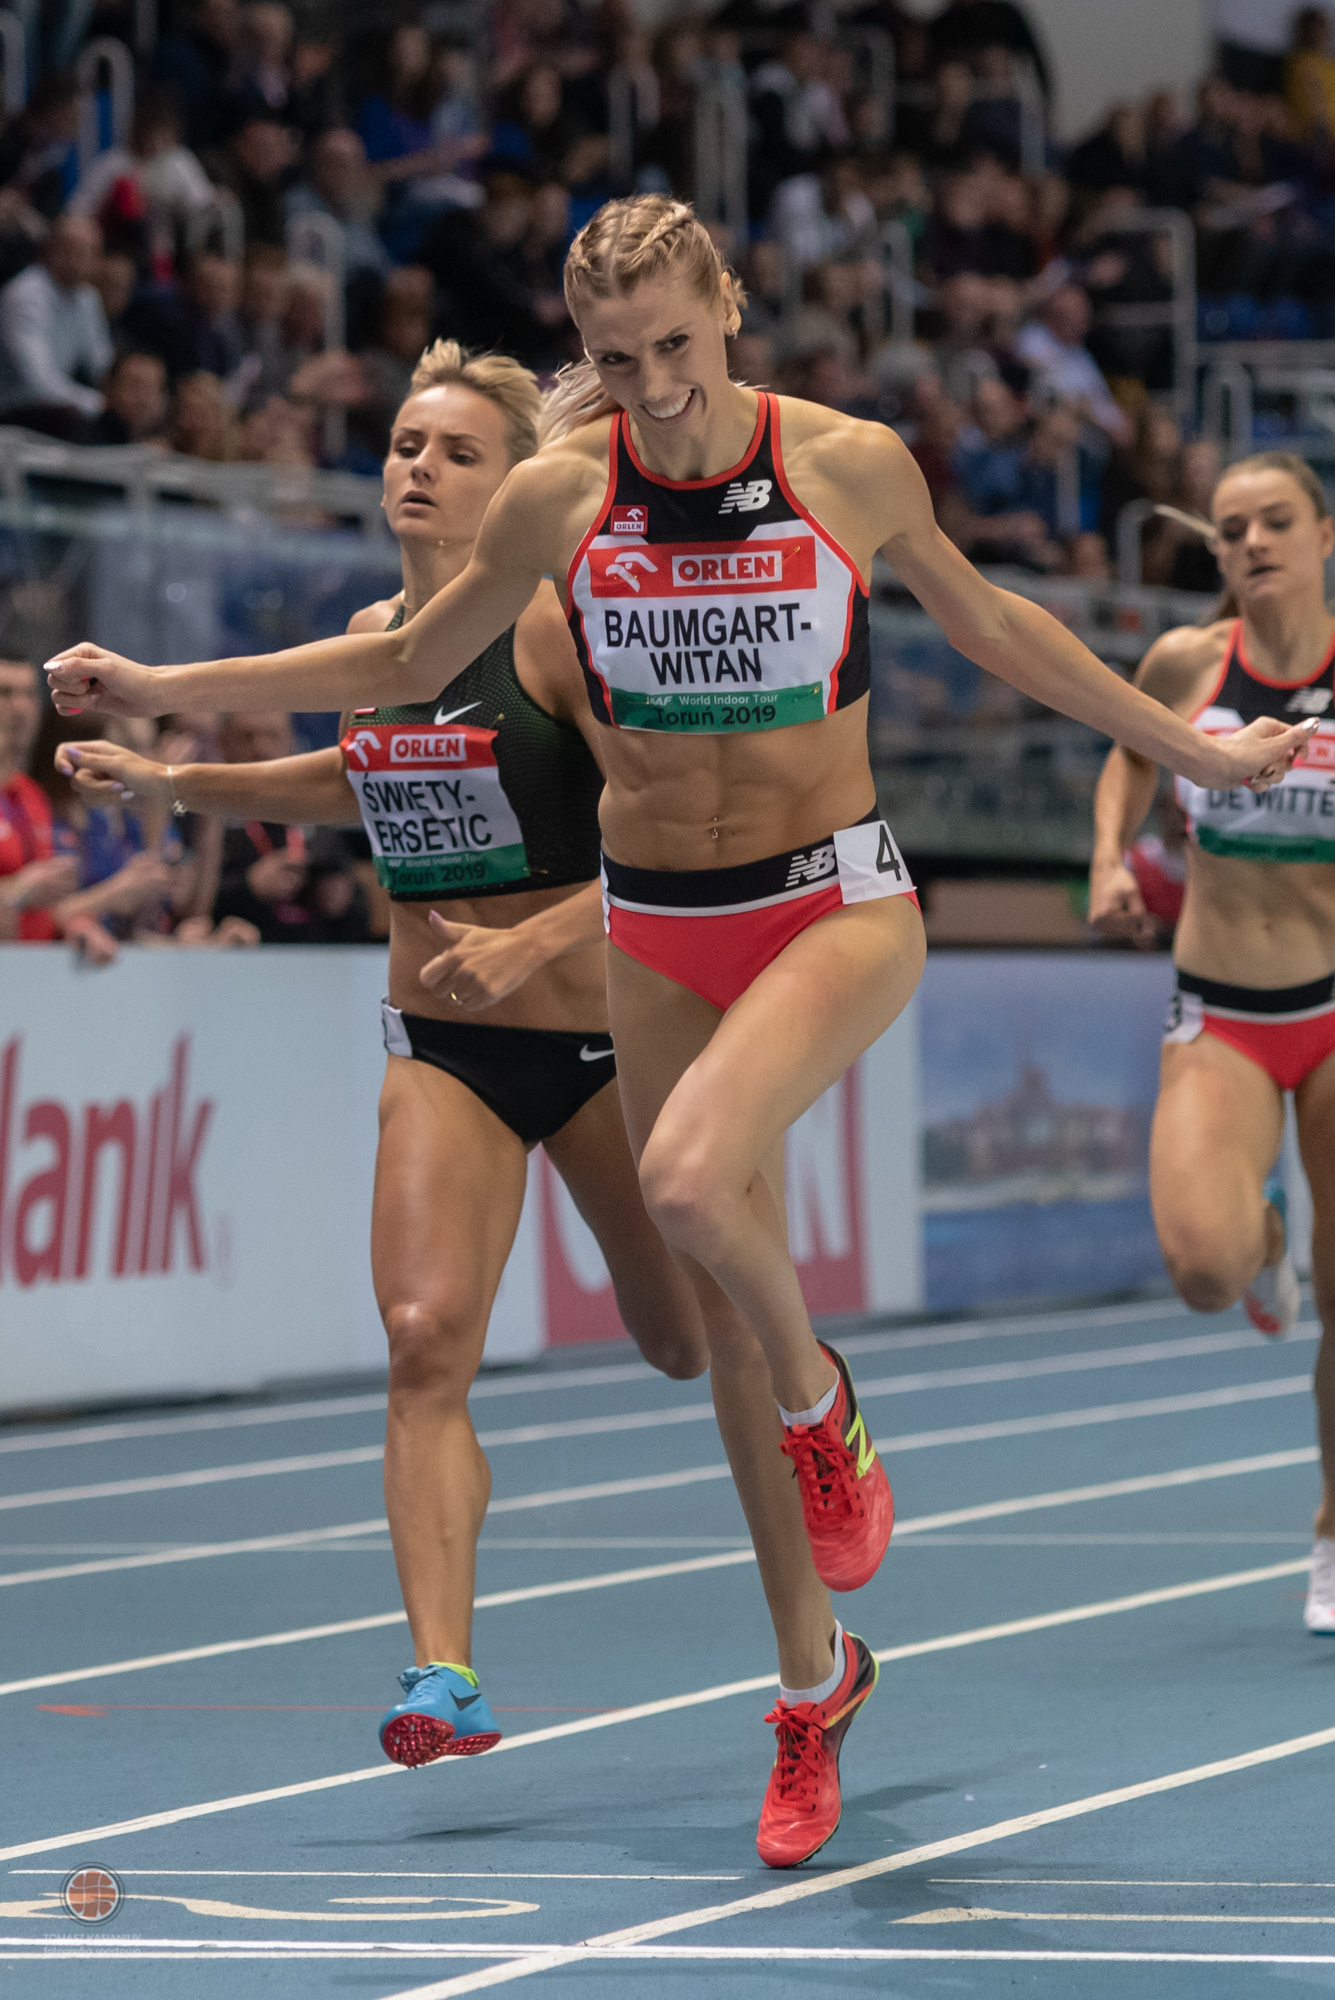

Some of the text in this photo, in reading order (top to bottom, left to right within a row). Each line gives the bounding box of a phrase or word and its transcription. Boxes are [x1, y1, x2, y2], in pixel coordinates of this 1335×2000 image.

[677, 555, 777, 582] ORLEN
[604, 603, 812, 648] BAUMGART-
[650, 648, 762, 686] WITAN
[679, 695, 711, 705] World
[714, 694, 750, 705] Indoor
[752, 693, 779, 704] Tour
[652, 704, 777, 726] Toruń 2019
[395, 737, 460, 759] ORLEN
[374, 814, 493, 853] ERSETIC
[876, 824, 902, 882] 4
[441, 862, 486, 882] 2019
